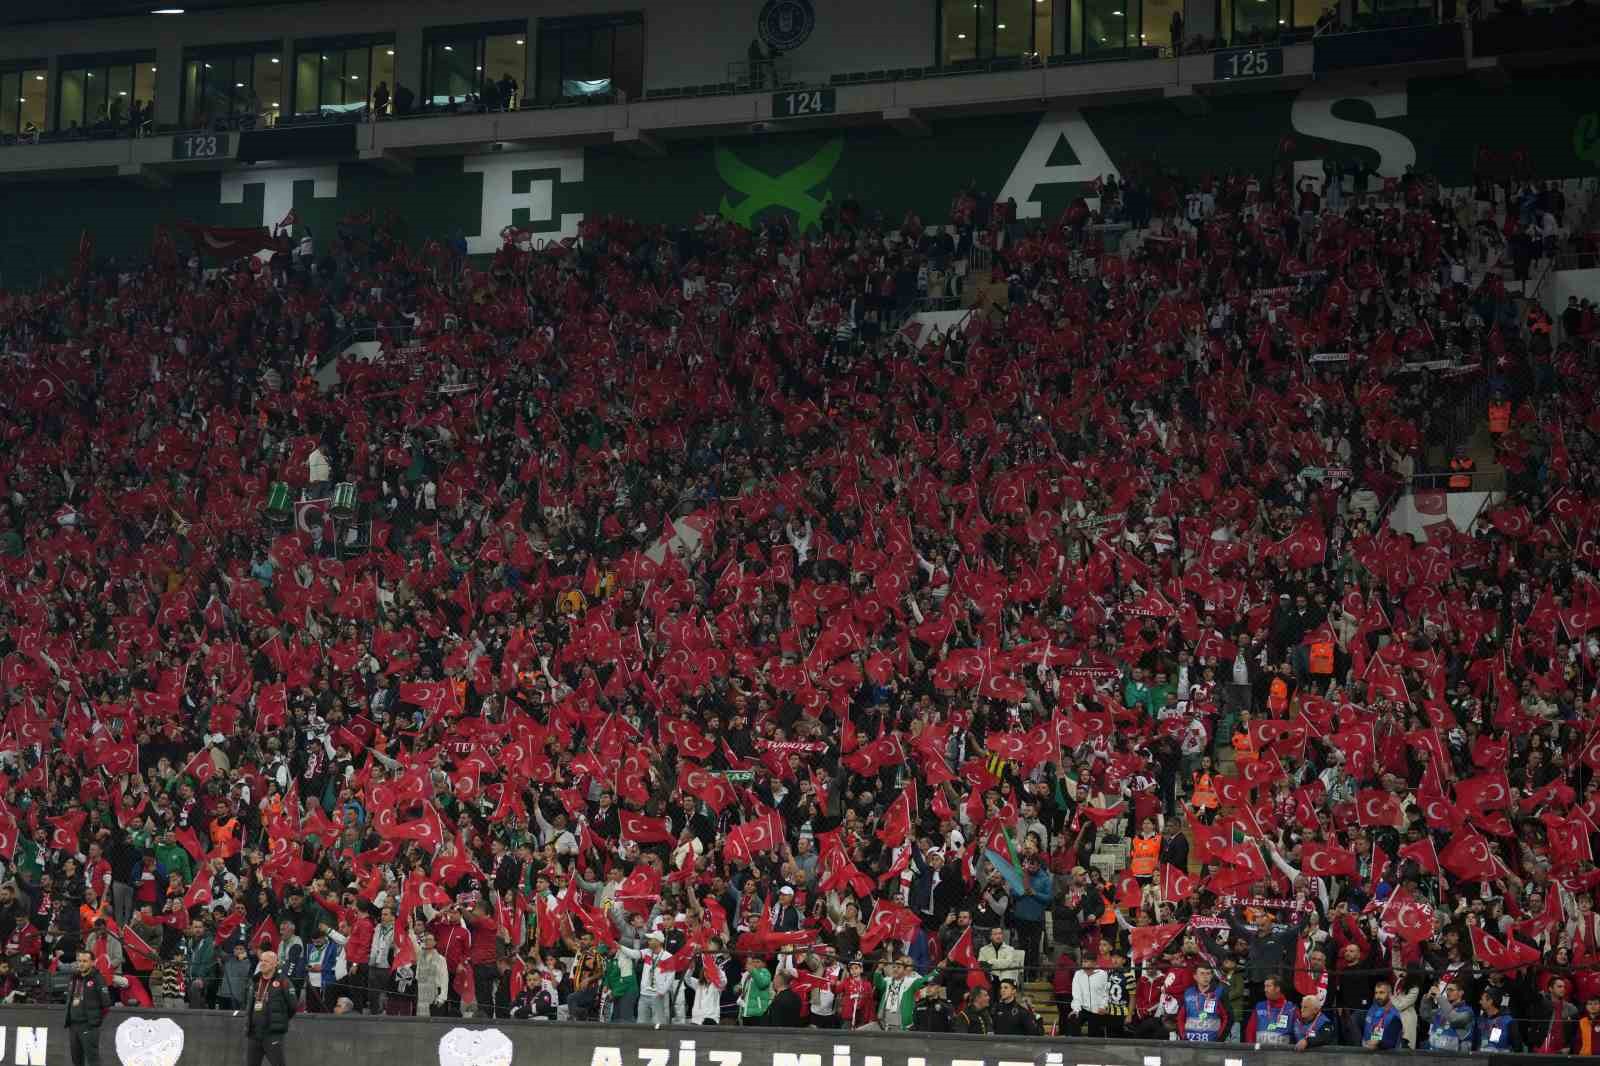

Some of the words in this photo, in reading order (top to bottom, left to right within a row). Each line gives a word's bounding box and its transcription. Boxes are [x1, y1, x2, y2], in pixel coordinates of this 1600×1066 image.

[1229, 52, 1269, 76] 125
[786, 93, 822, 115] 124
[185, 136, 217, 156] 123
